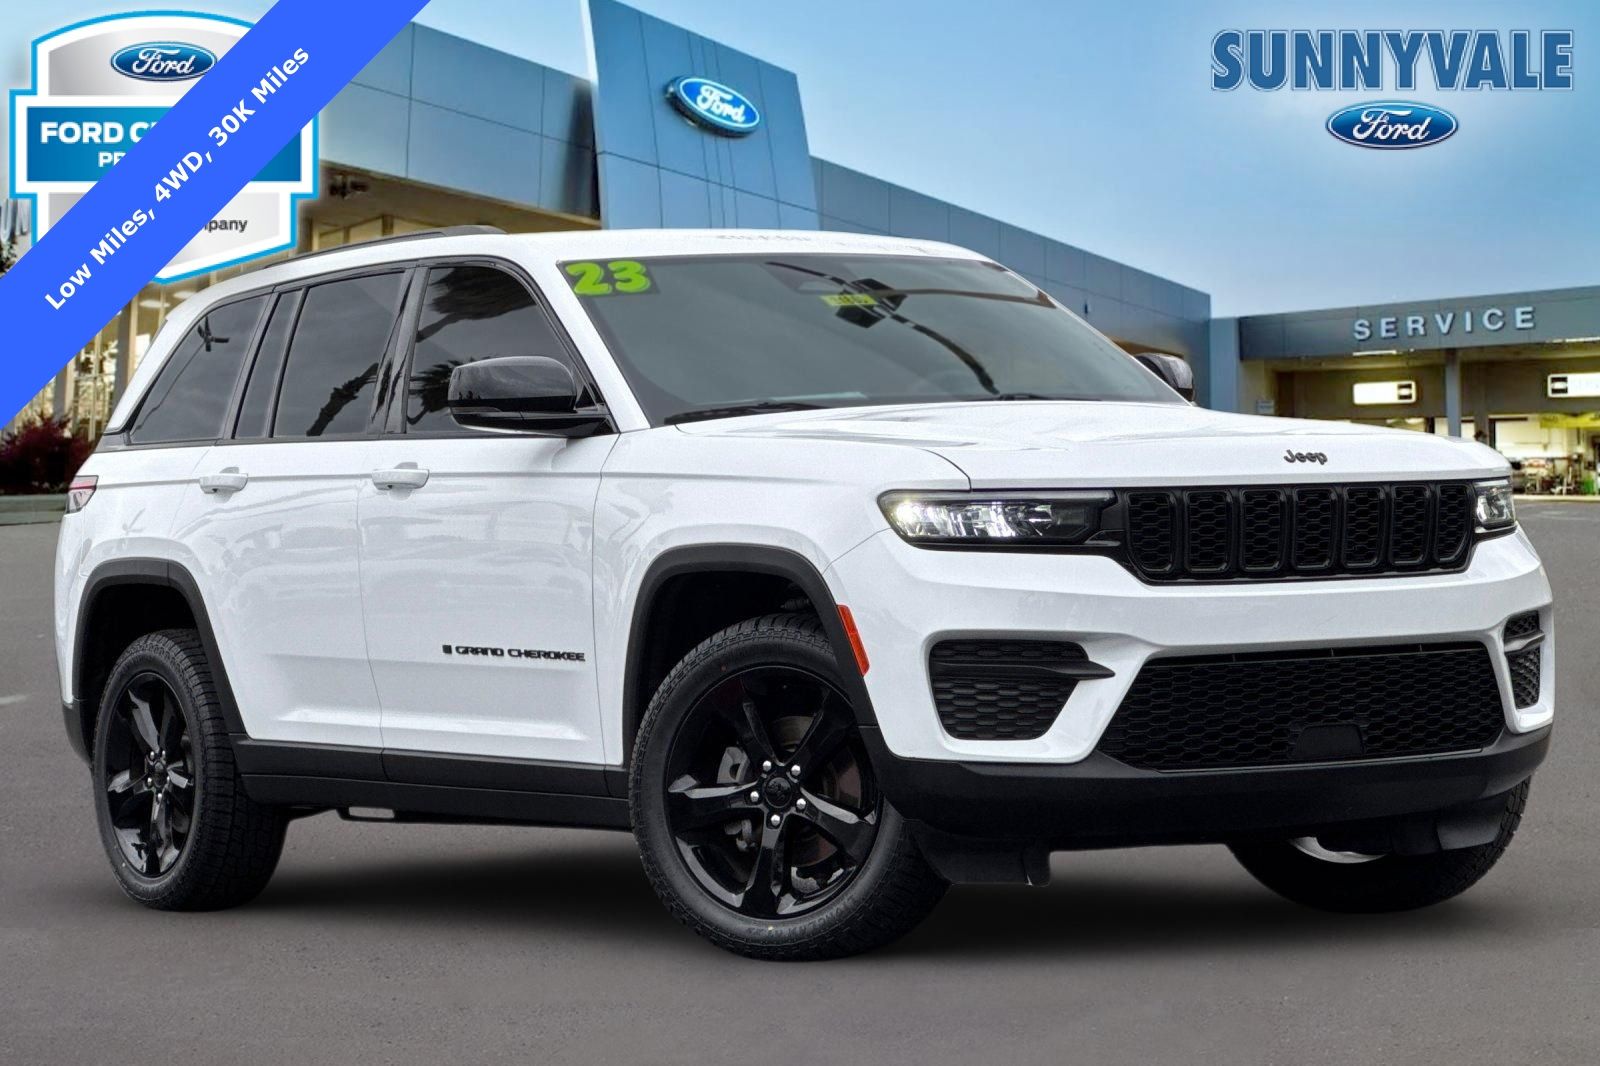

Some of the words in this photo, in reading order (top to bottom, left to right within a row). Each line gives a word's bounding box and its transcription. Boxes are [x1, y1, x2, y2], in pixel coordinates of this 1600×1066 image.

[696, 85, 746, 122] Ford
[565, 260, 651, 296] 23
[1353, 306, 1536, 341] SERVICE
[1283, 449, 1328, 466] Jeep
[455, 645, 505, 657] GRAND
[507, 648, 586, 662] CHEROKEE
